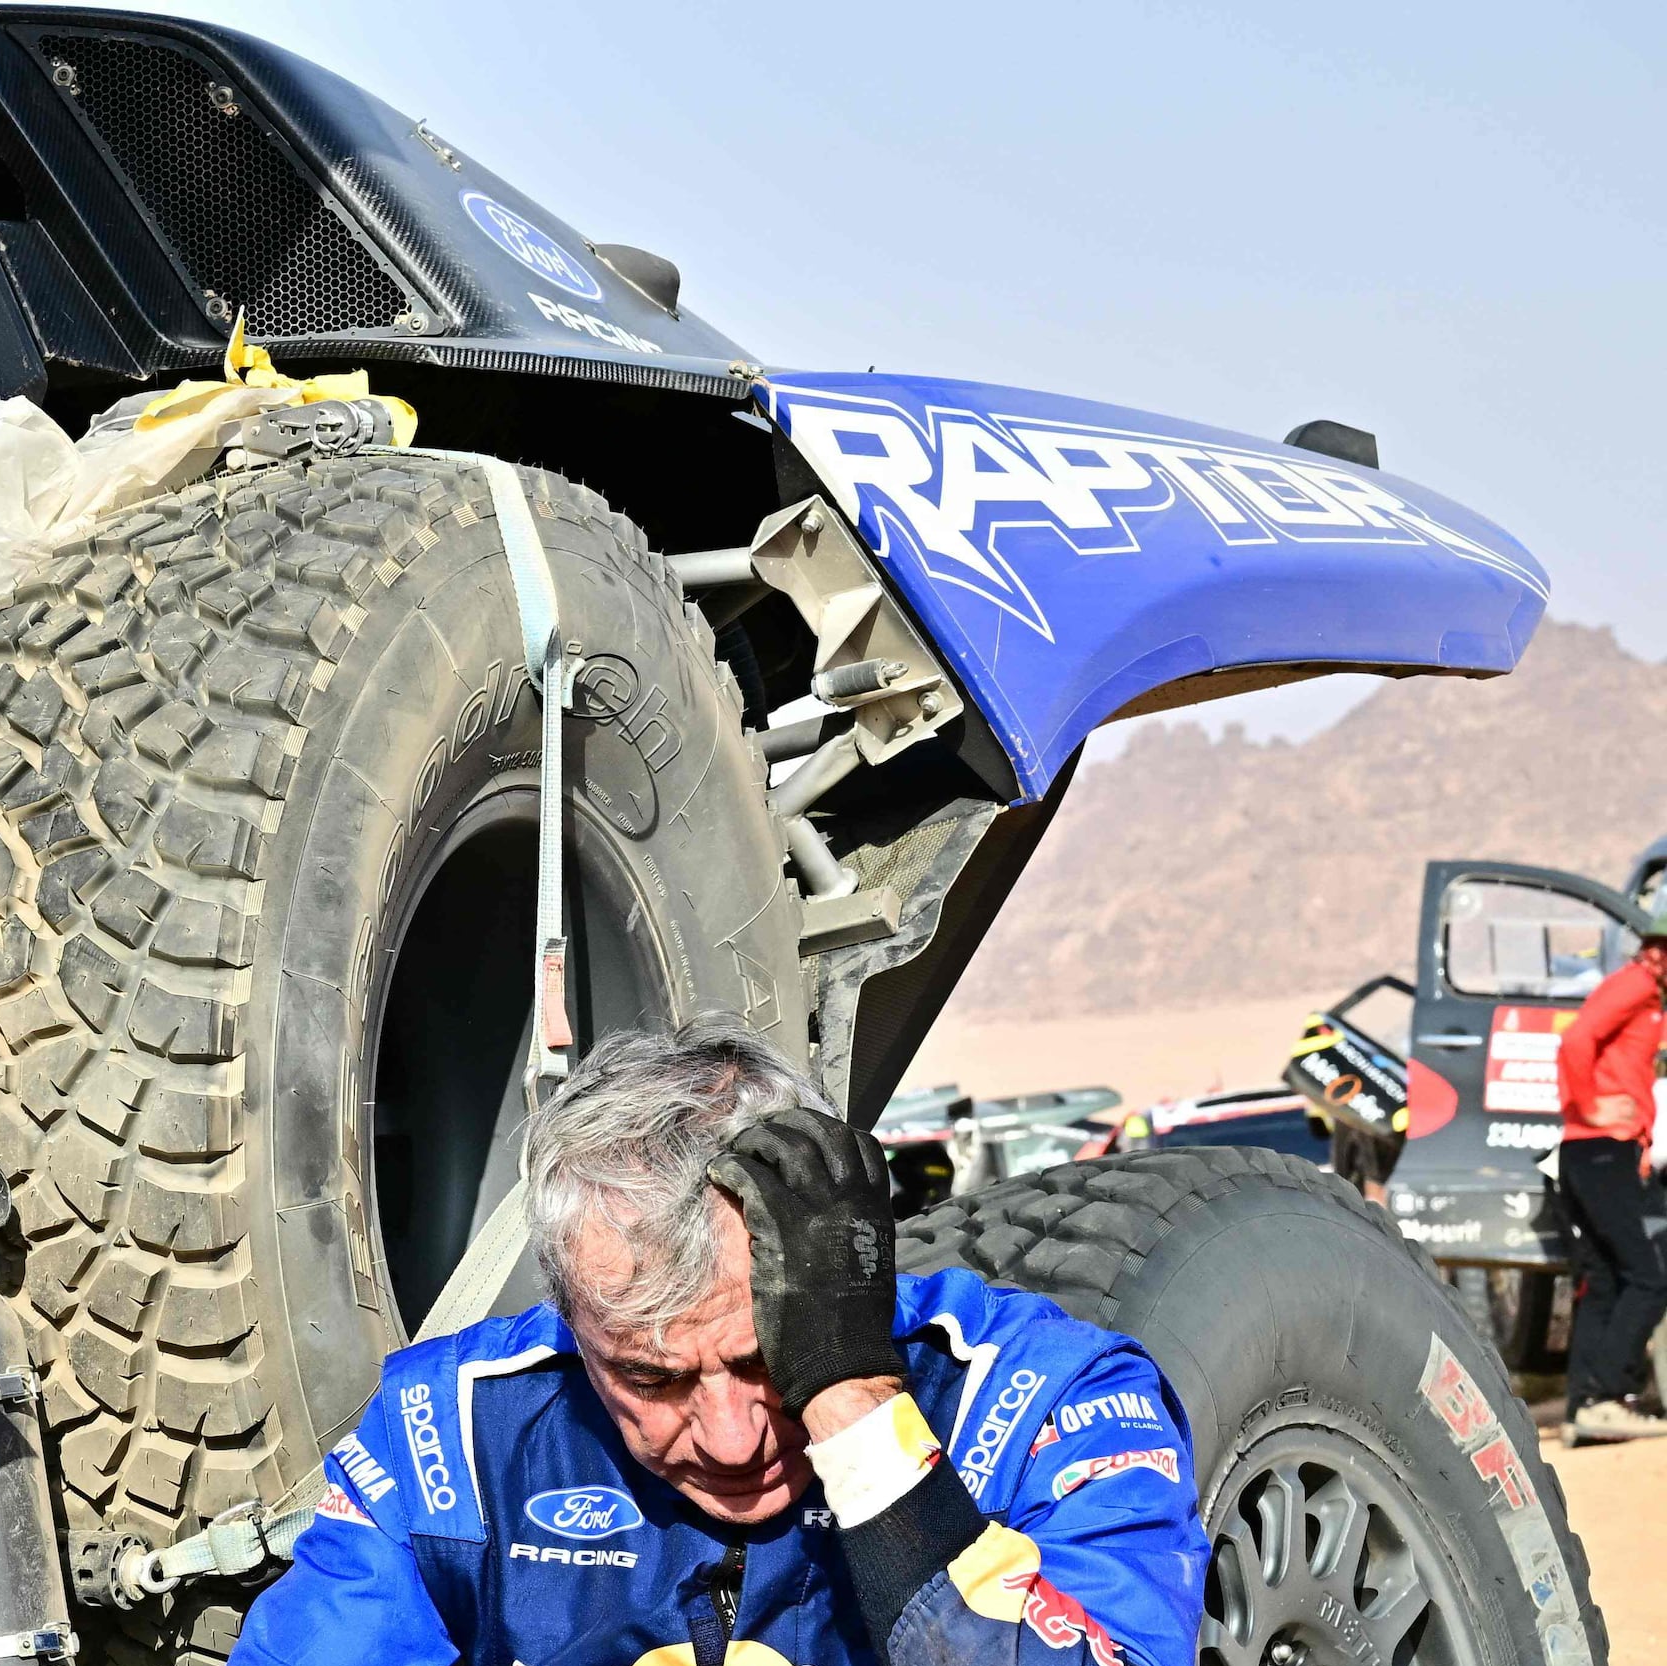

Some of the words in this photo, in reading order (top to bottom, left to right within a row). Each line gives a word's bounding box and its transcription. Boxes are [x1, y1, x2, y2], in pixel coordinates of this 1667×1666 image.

[486, 204, 585, 288] Ford
[782, 390, 1527, 620] RAPTOR
[400, 1383, 456, 1515] sparco
[960, 1368, 1047, 1500] sparco
[1060, 1393, 1158, 1434] OPTIMA
[553, 1494, 620, 1531] Ford
[509, 1543, 639, 1570] RACING
